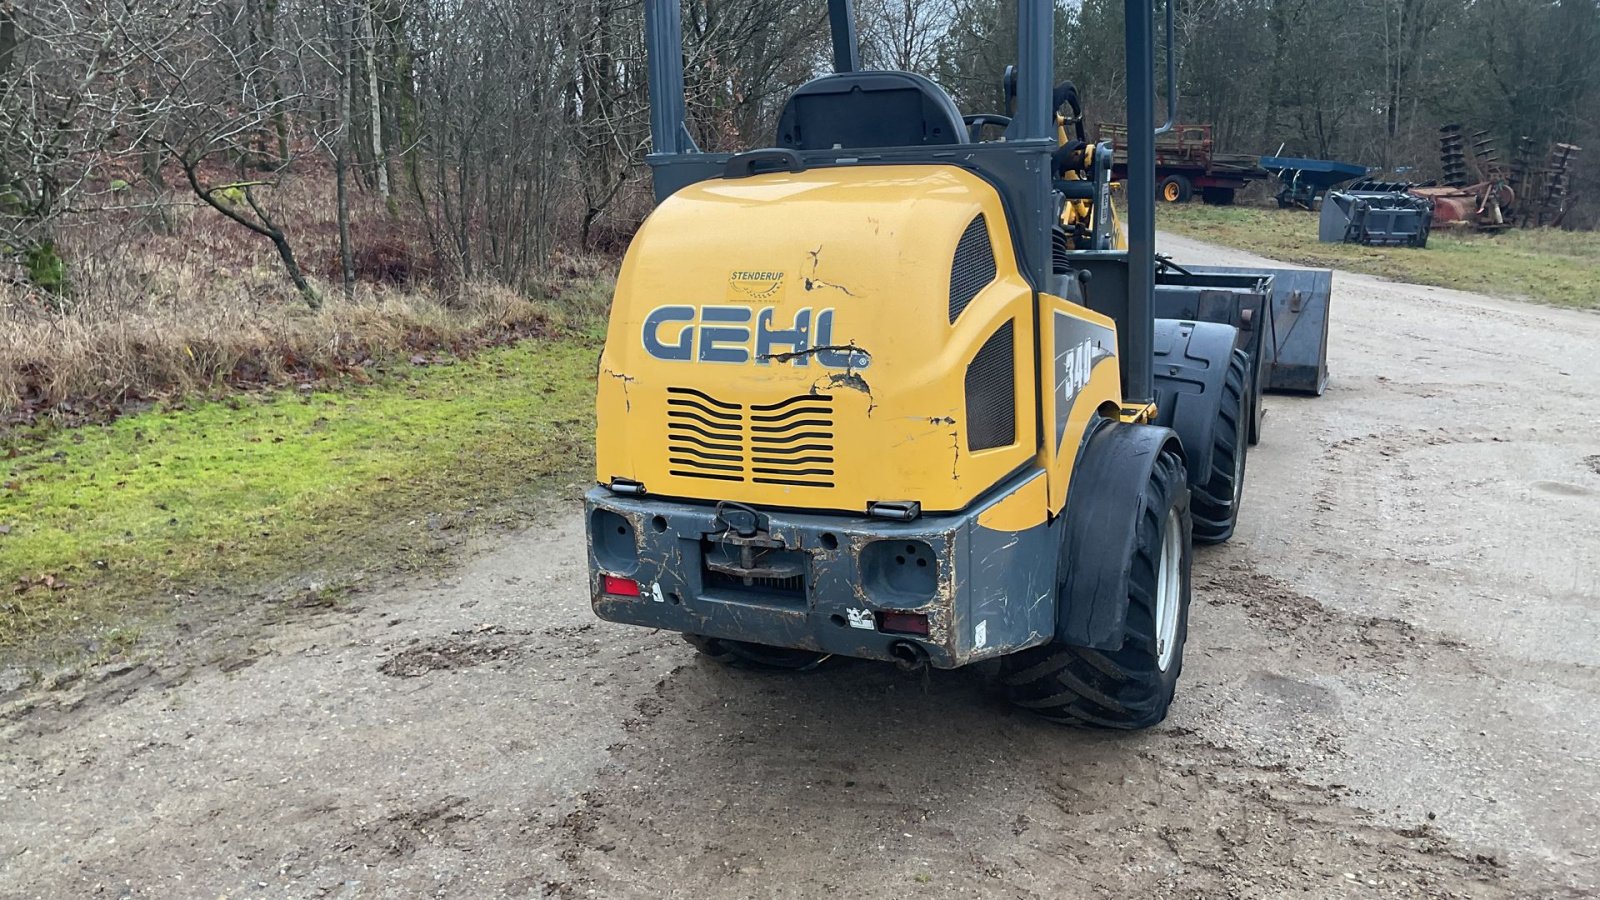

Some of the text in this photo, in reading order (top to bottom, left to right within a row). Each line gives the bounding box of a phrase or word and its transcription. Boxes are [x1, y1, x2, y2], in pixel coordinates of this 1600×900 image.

[731, 271, 784, 281] STENDERUP
[642, 304, 870, 370] GEHL
[1065, 336, 1092, 402] 340
